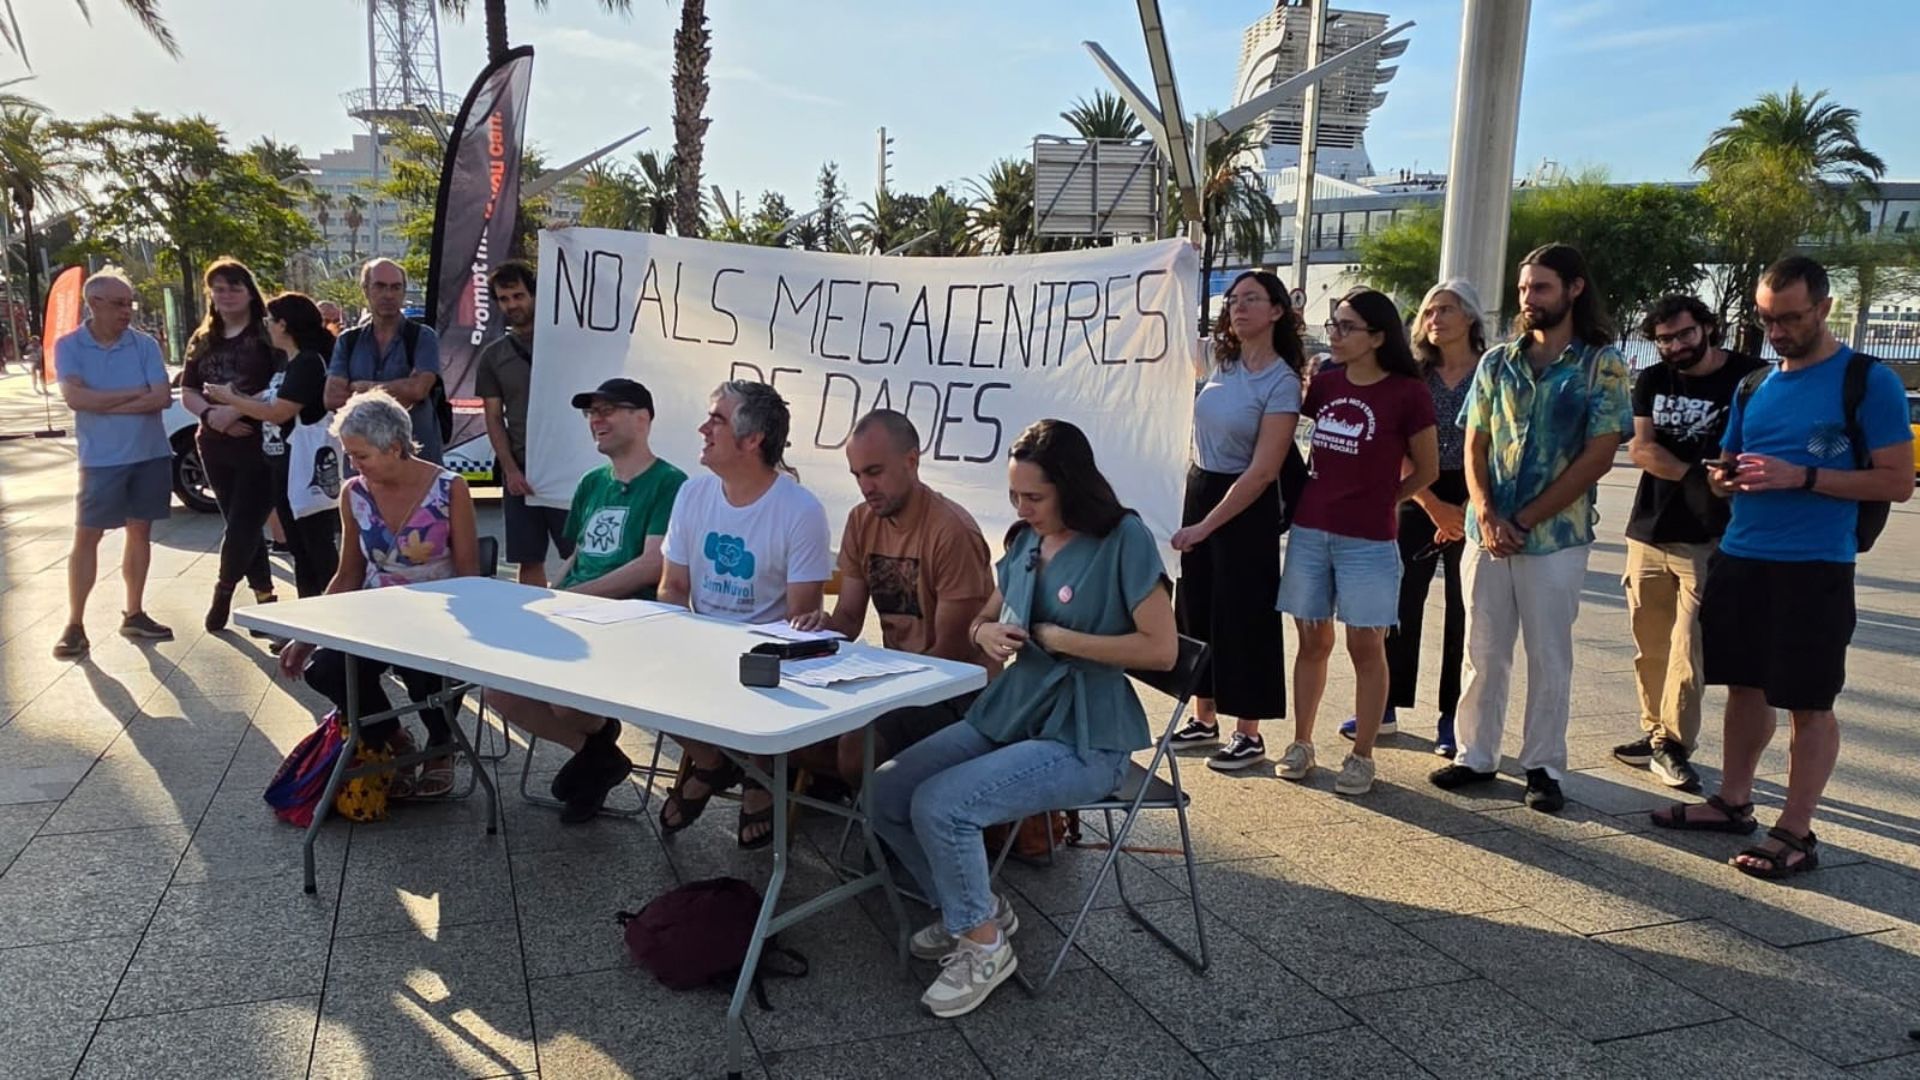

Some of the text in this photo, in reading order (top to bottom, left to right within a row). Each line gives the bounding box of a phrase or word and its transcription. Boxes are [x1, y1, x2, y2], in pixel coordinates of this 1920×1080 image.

[553, 247, 1168, 369] NO ALS MEGACENTRES
